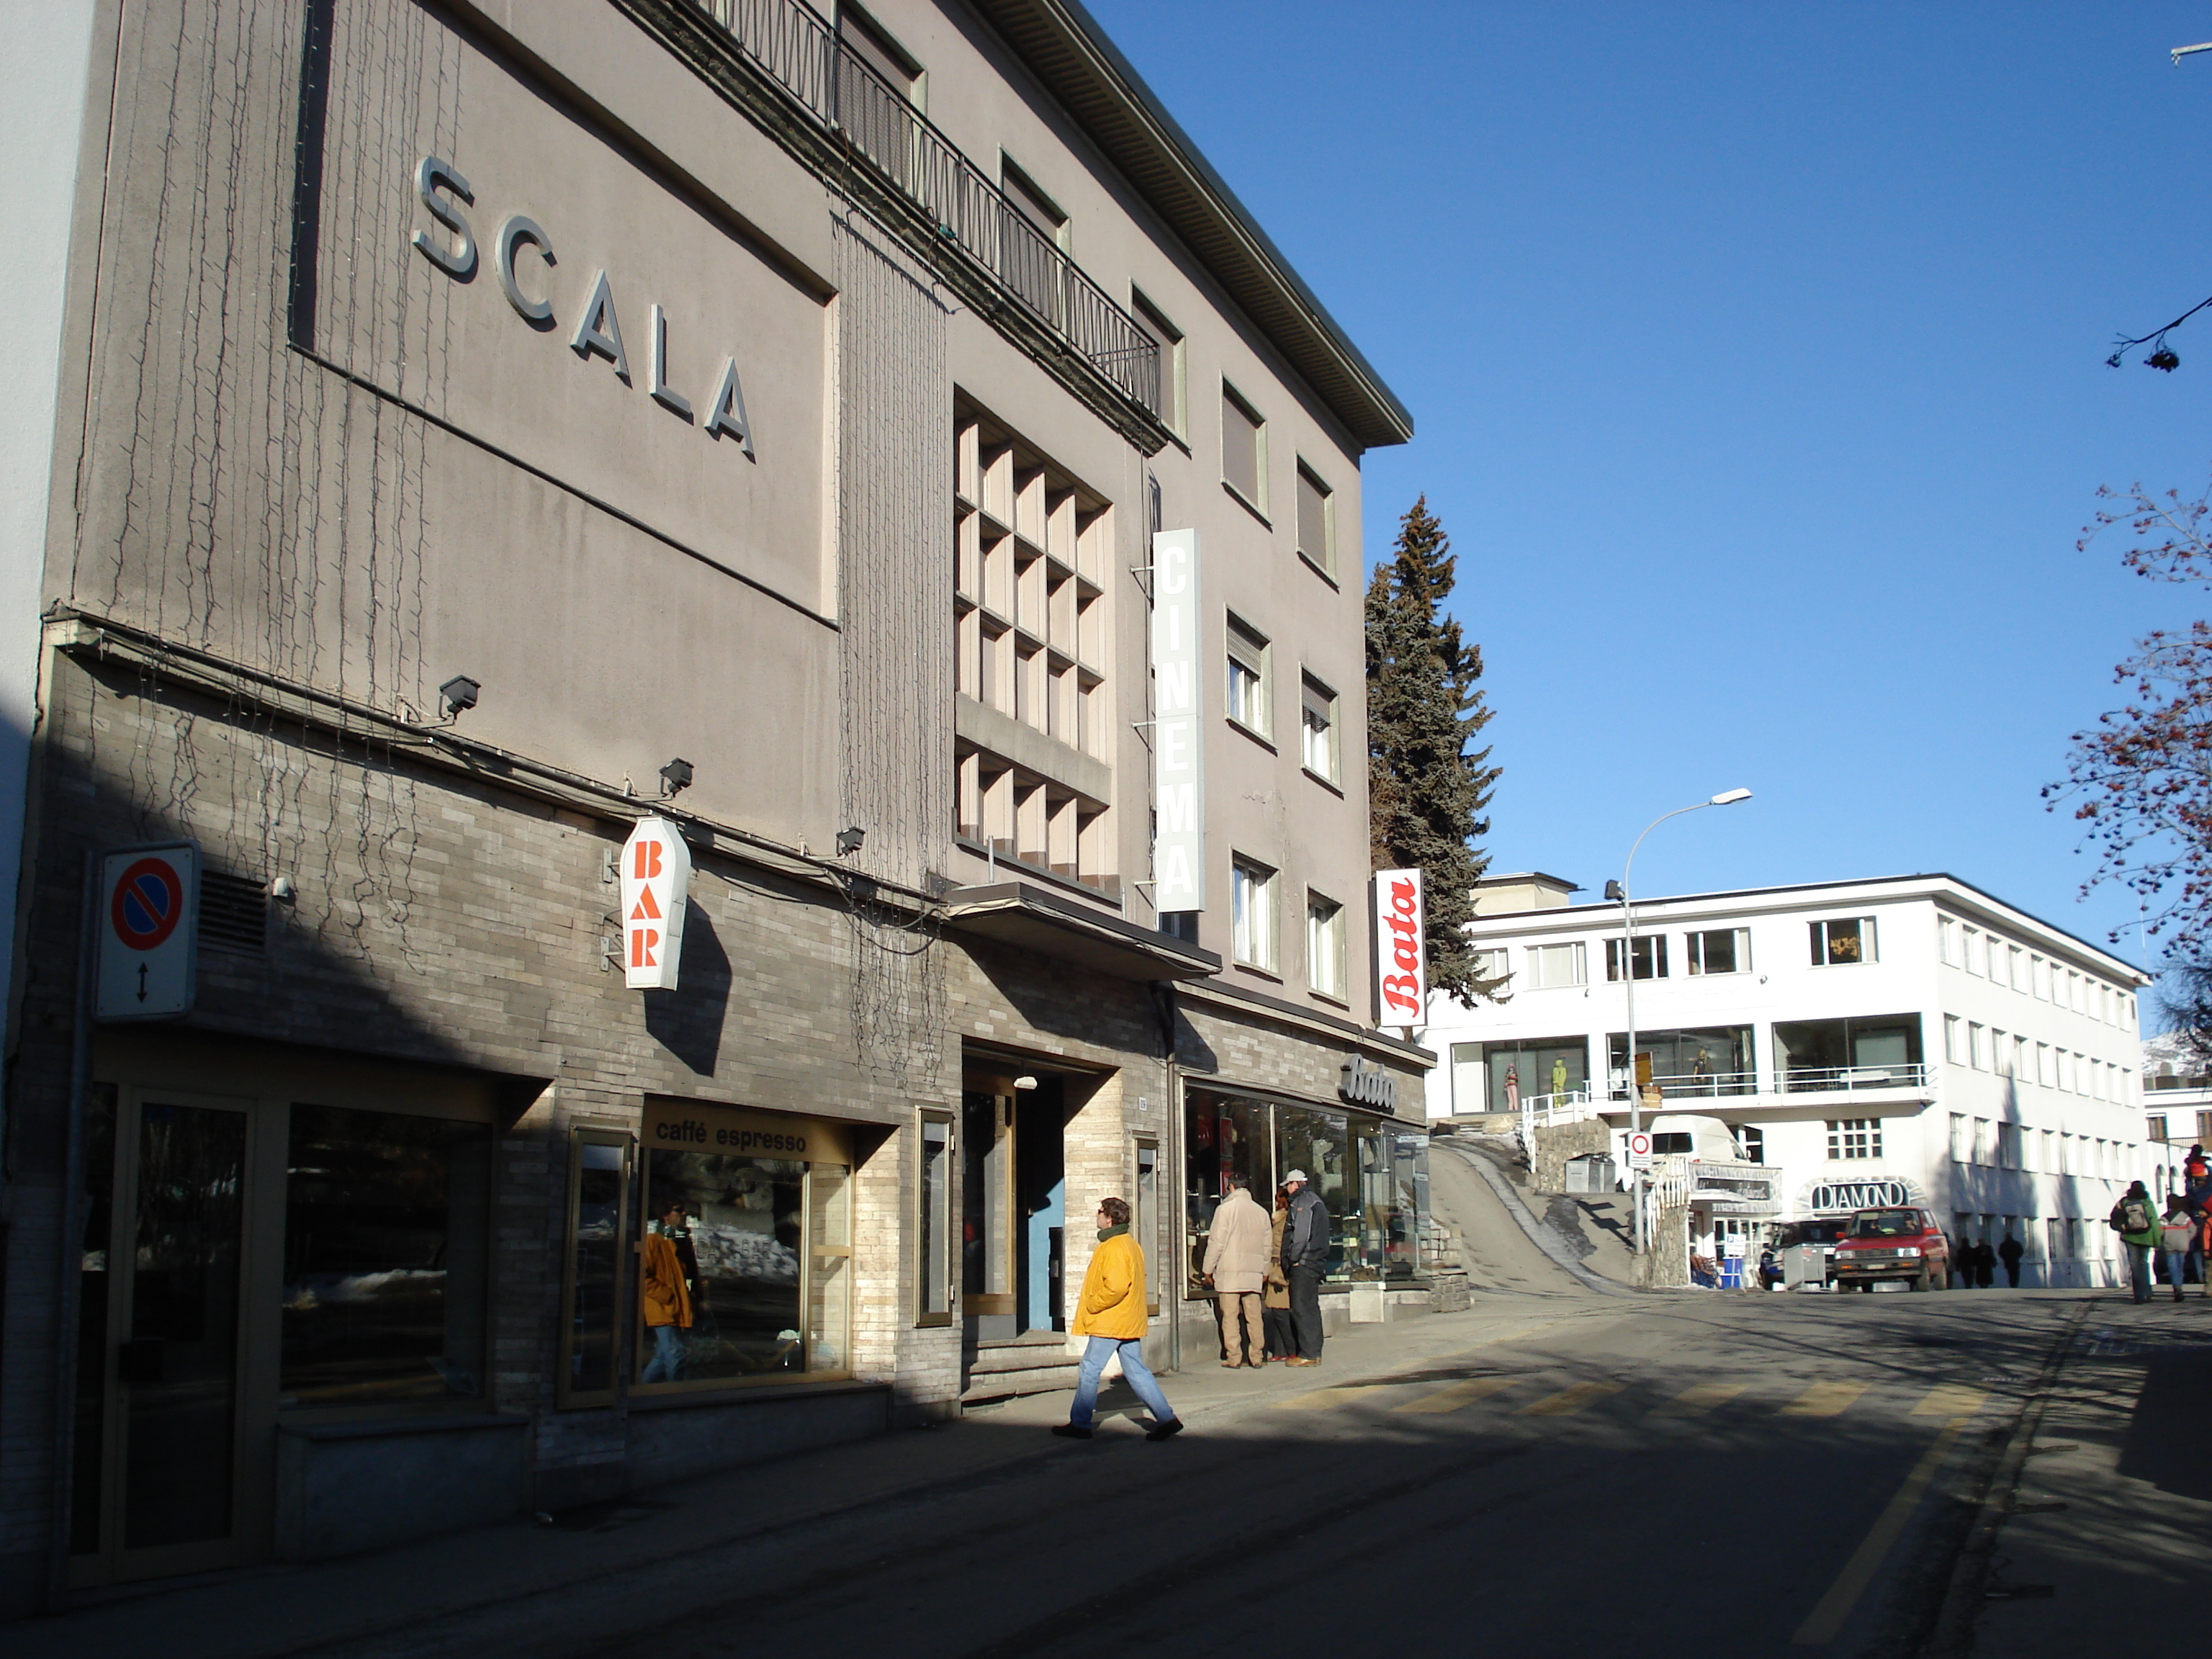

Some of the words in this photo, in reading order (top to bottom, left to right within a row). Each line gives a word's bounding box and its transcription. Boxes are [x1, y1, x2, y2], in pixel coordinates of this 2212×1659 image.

[413, 156, 755, 458] SCALA
[1159, 545, 1196, 895] CINEMA
[629, 840, 662, 967] BAR
[1382, 876, 1420, 1018] Bata
[716, 1127, 806, 1153] espresso
[1340, 1053, 1397, 1109] Bata
[1818, 1181, 1905, 1210] DIAMOND
